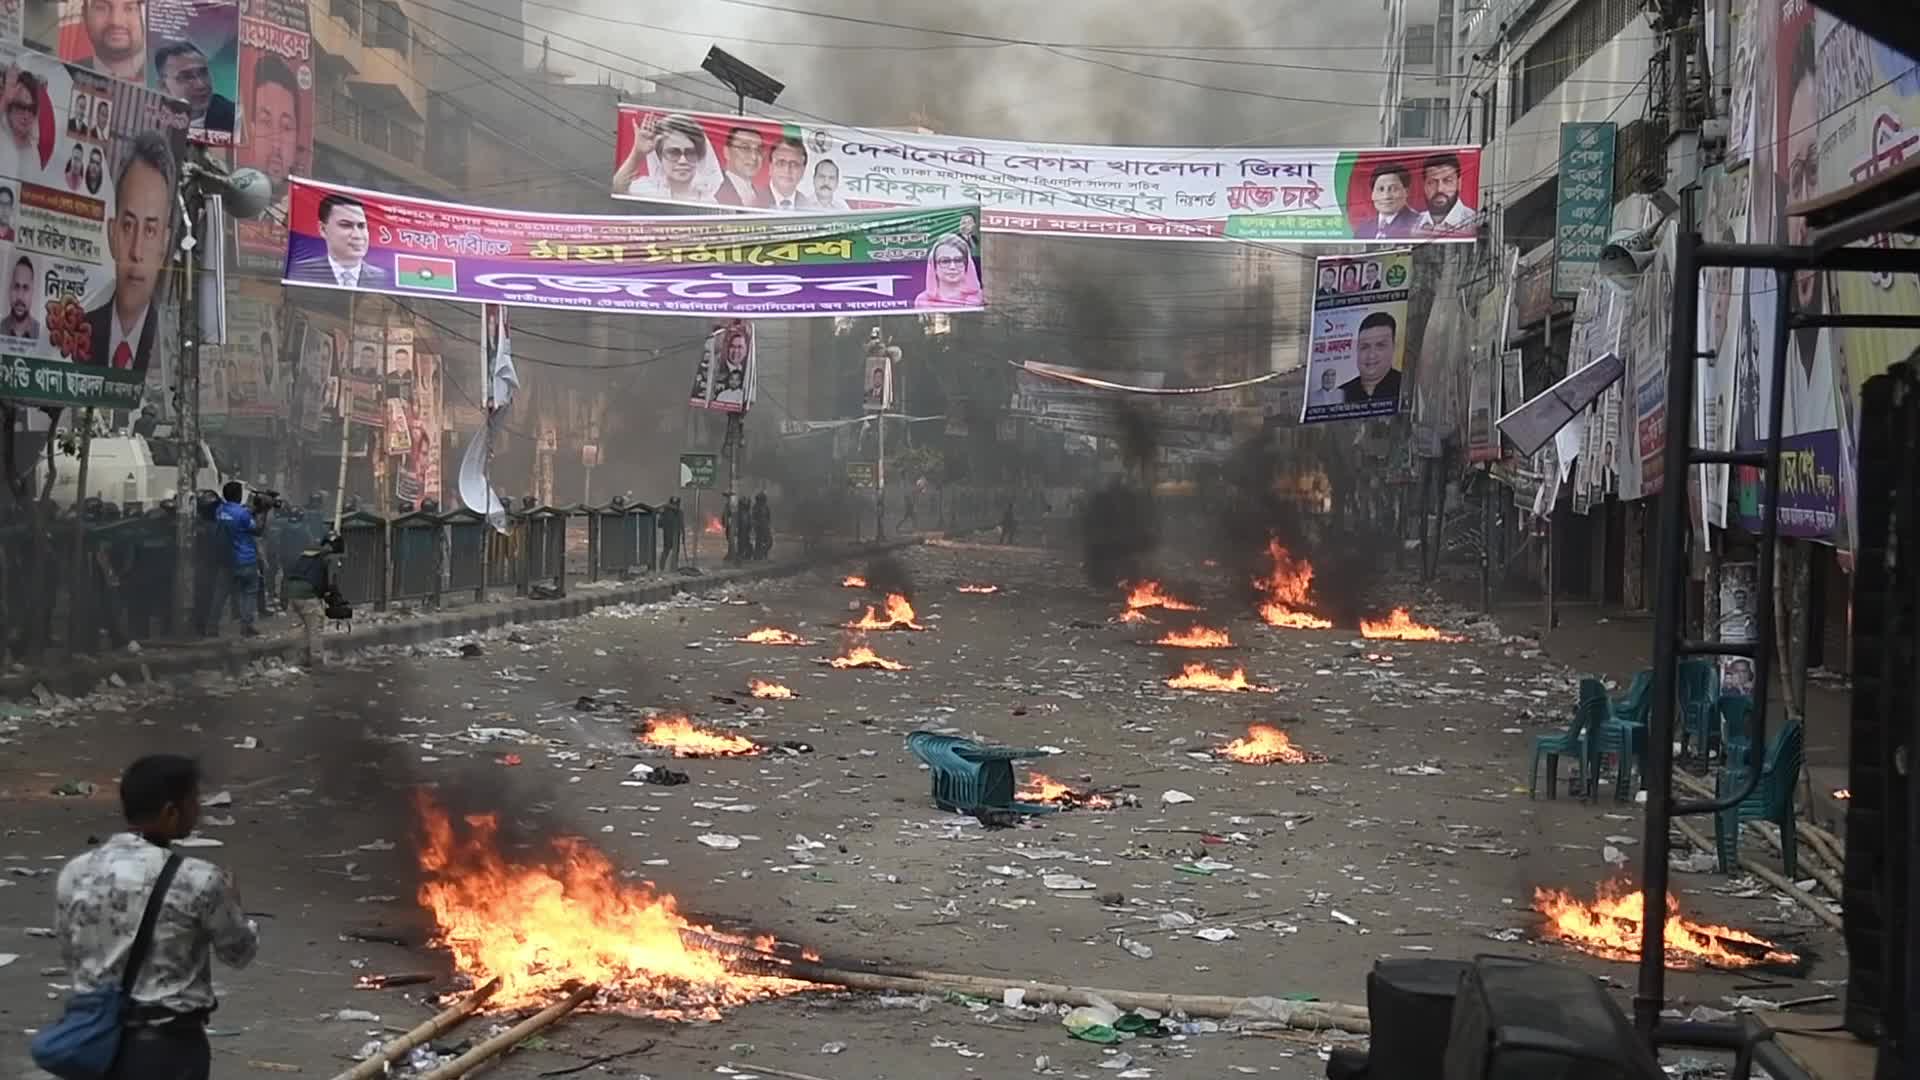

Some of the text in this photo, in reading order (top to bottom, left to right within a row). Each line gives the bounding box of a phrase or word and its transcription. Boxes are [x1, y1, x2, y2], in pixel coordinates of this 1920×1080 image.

[842, 142, 1320, 178] দেশনেত্রী বেগম খালেদা জিয়া
[843, 173, 950, 201] রফিকুল
[960, 179, 1056, 206] ইসলাম
[1226, 180, 1278, 212] মুক্তি
[1280, 179, 1325, 209] চাই
[988, 214, 1041, 229] ঢাকা
[1048, 218, 1137, 233] মহানগর
[379, 225, 392, 244] ১
[397, 228, 439, 250] দফা
[527, 239, 854, 267] মহা সমাবেশ
[474, 272, 913, 298] জেটেব
[847, 298, 909, 311] বাংলাদেশ
[35, 367, 63, 393] থানা
